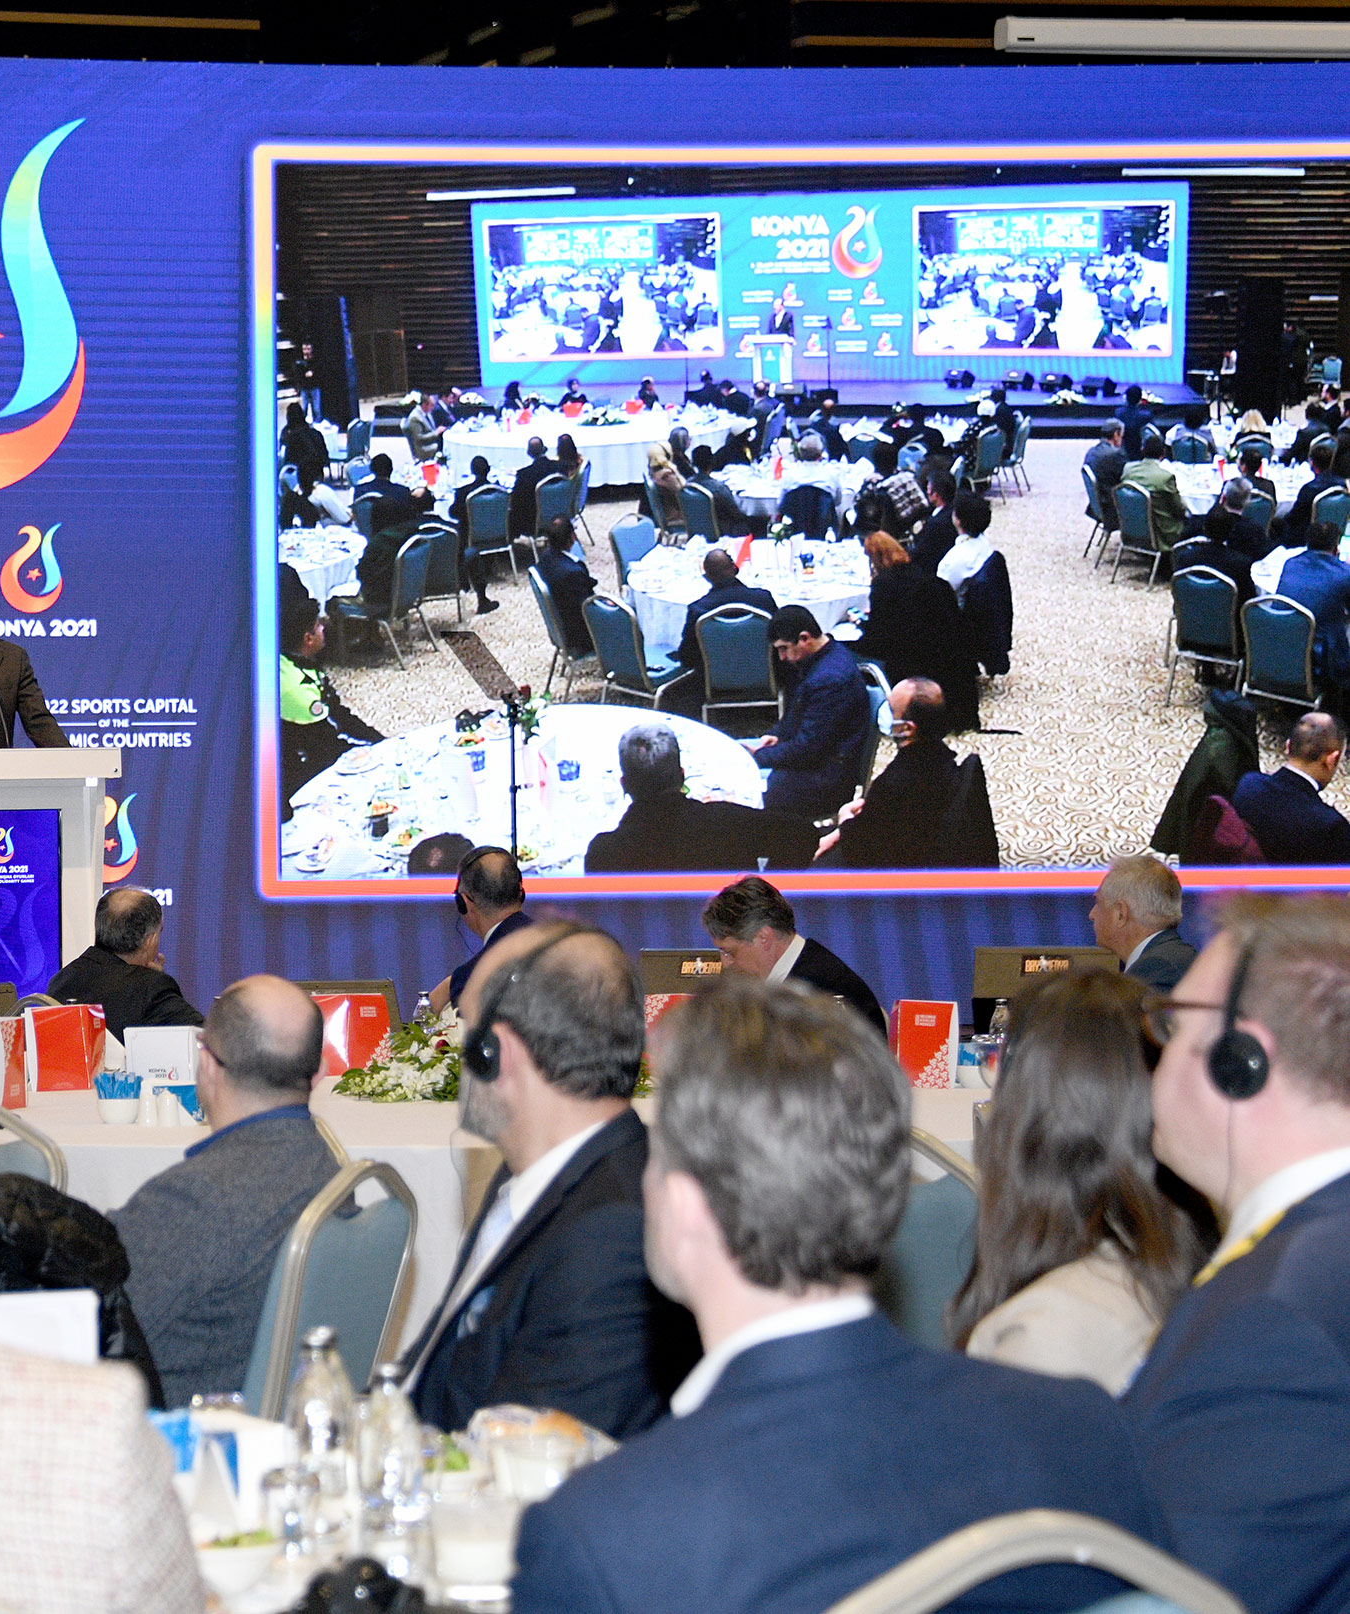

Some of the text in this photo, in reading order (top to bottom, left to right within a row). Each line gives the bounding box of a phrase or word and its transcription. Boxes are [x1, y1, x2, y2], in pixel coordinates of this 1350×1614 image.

[776, 239, 829, 259] 2021
[49, 618, 97, 637] 2021
[45, 698, 198, 714] 22 SPORTS CAPITAL
[97, 718, 130, 728] OF THE
[102, 732, 192, 748] COUNTRIES
[8, 865, 29, 873] 2021
